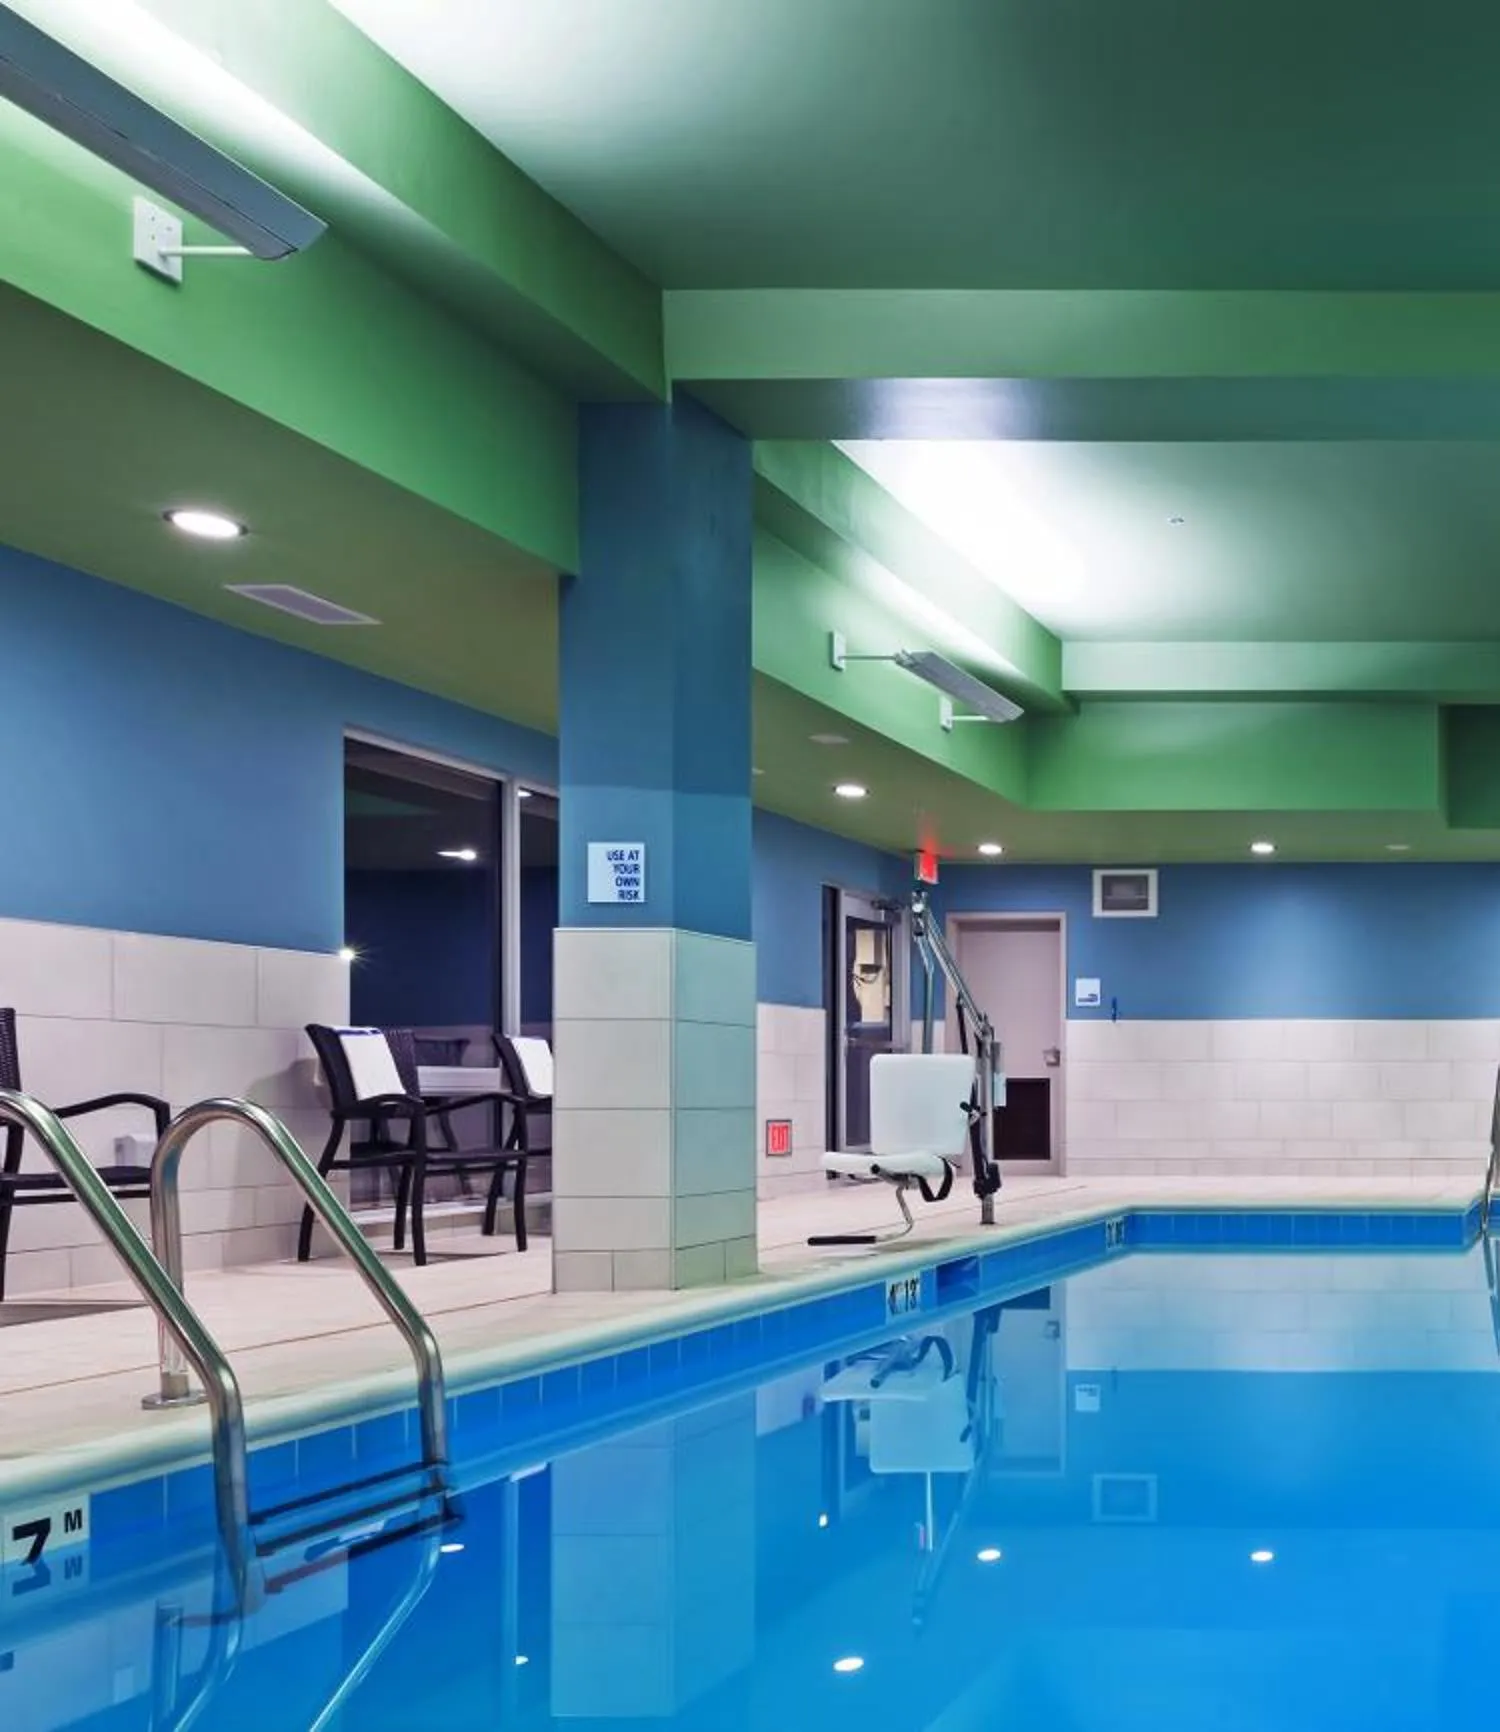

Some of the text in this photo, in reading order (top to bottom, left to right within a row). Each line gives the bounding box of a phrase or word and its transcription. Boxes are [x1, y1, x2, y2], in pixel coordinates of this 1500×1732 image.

[607, 850, 639, 861] USE AT
[613, 864, 640, 874] YOUR
[615, 877, 639, 887] OWN
[618, 890, 639, 901] RISK
[12, 1508, 82, 1565] 7 M
